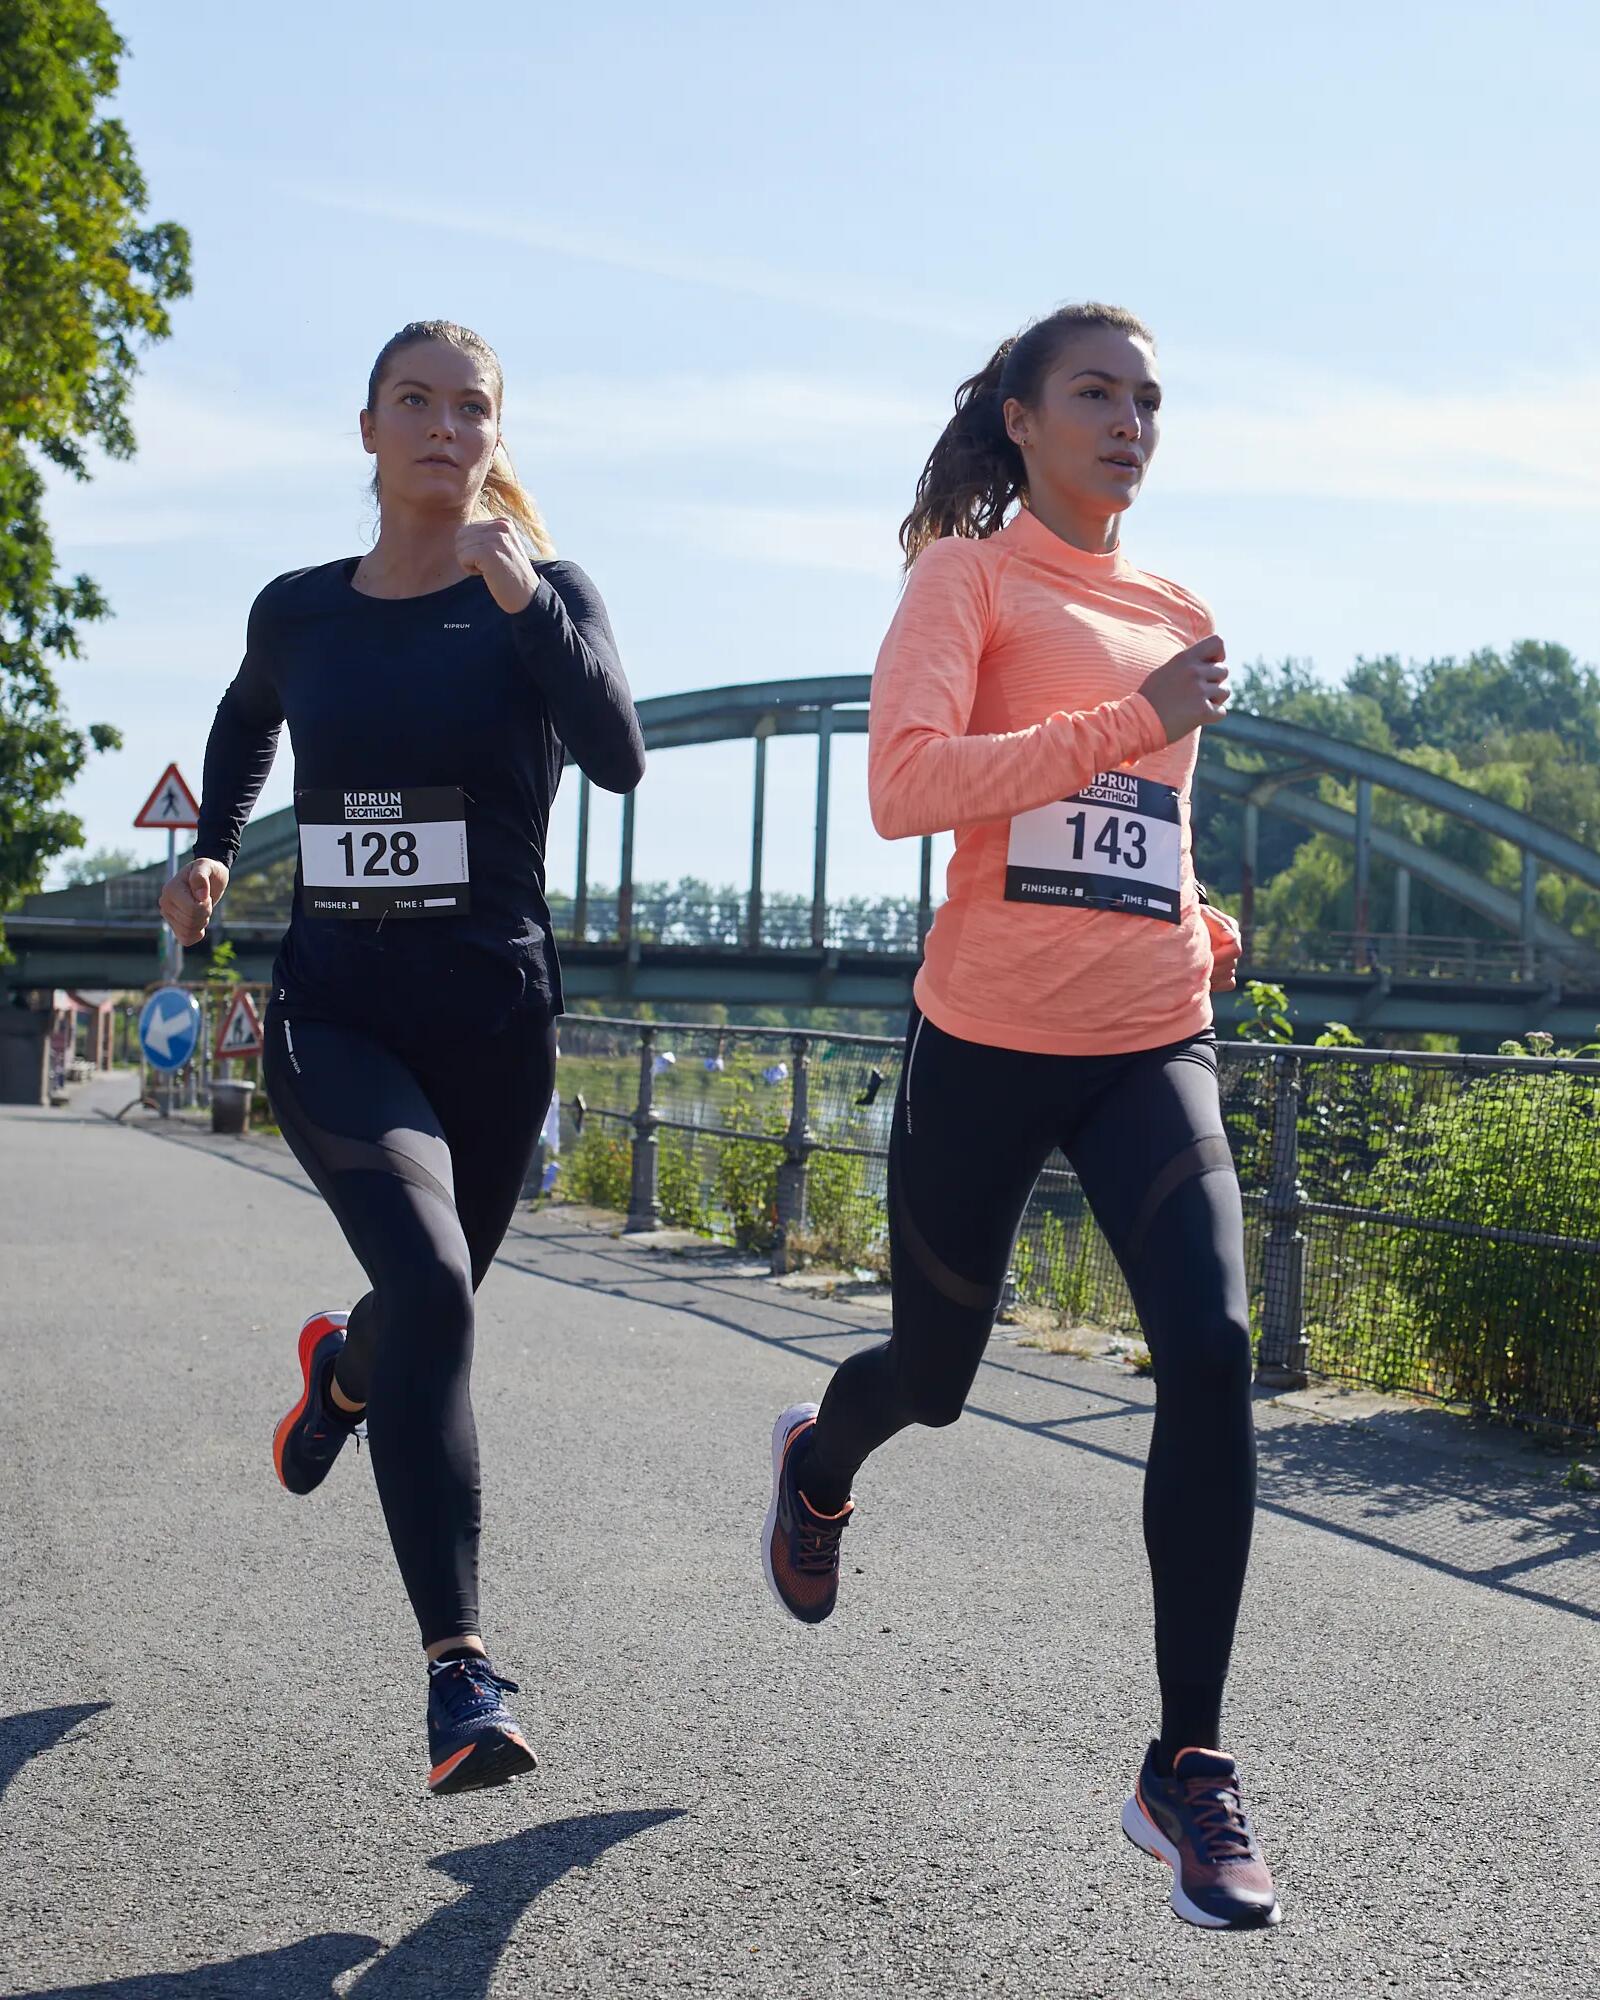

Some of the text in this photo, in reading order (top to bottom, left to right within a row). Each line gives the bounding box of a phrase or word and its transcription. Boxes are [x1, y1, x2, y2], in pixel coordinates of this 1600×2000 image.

[344, 792, 402, 805] KIPRUN
[1081, 786, 1136, 805] DECATHLON
[346, 807, 400, 818] DECATHLON
[1066, 811, 1147, 869] 143
[337, 831, 419, 876] 128
